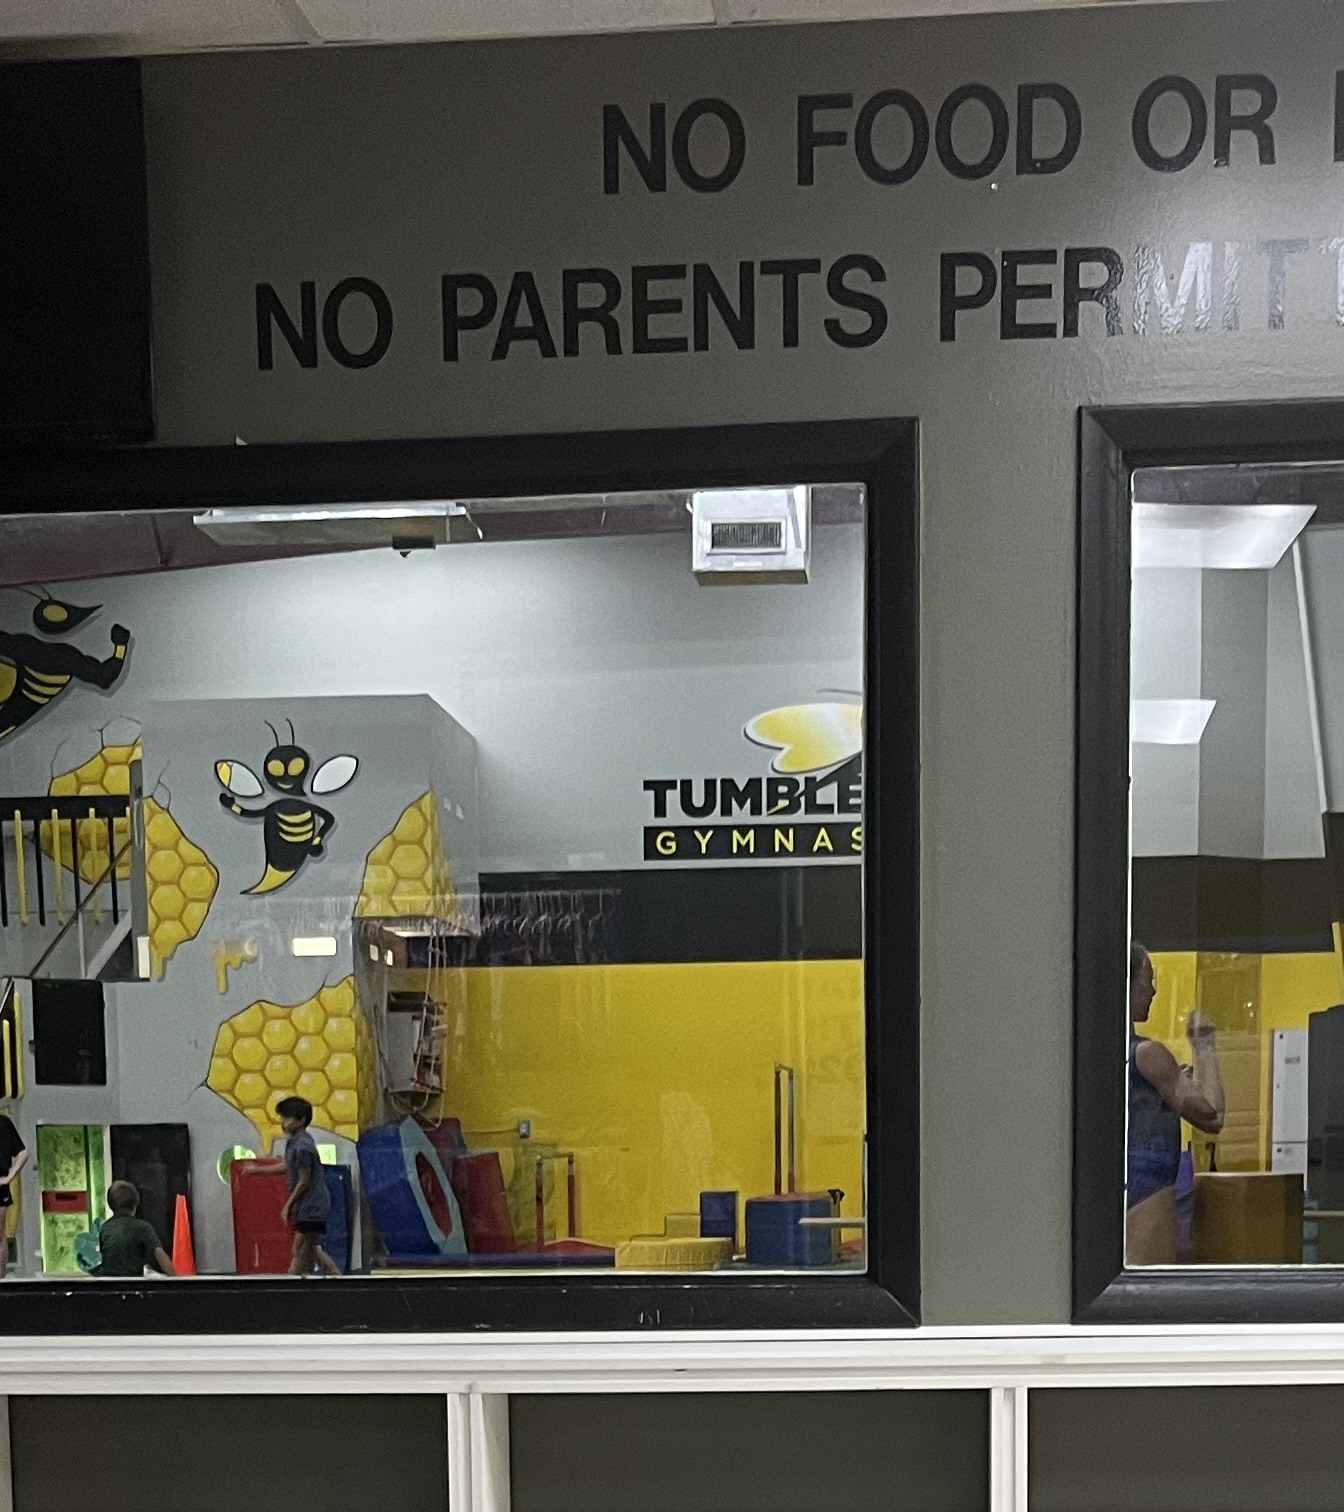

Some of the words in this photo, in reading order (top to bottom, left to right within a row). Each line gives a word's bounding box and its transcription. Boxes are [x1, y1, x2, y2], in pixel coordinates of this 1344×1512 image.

[602, 97, 746, 195] NO
[797, 82, 1083, 187] FOOD
[1131, 74, 1278, 173] OR
[256, 274, 394, 371] NO
[441, 254, 889, 364] PARENTS
